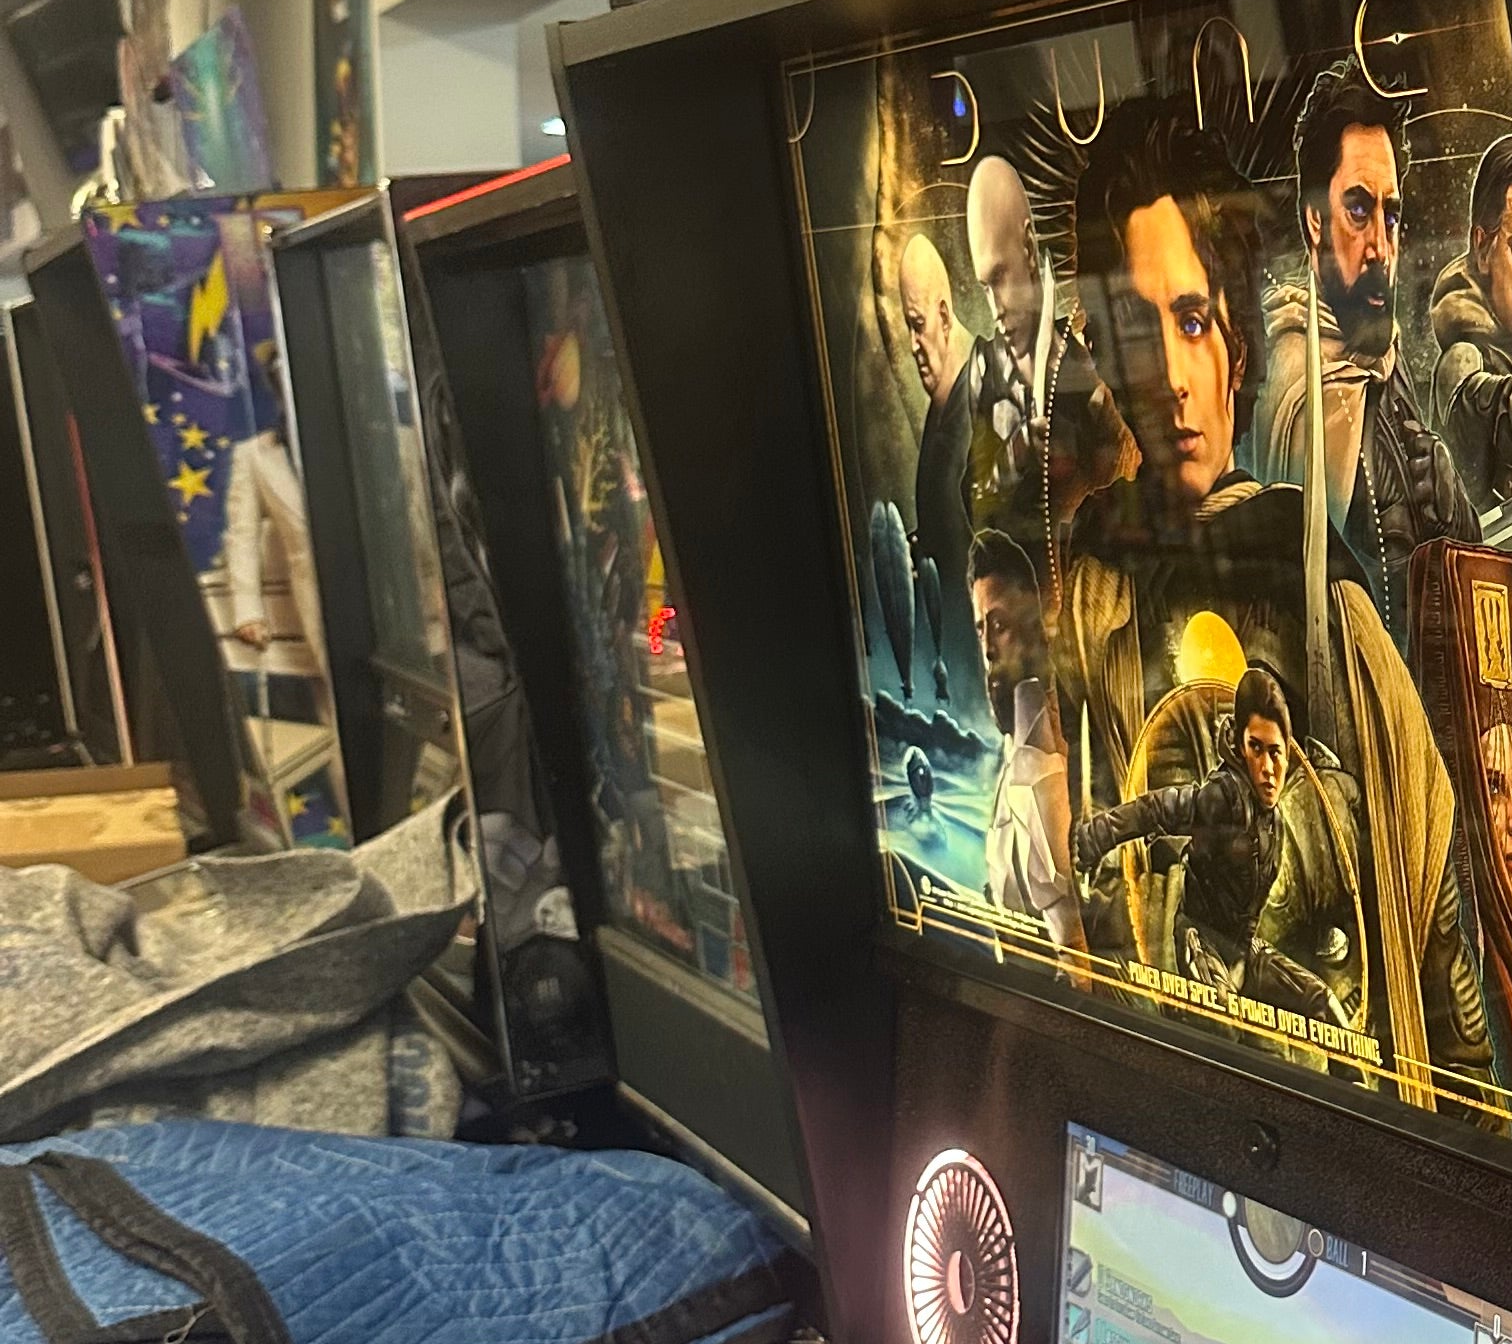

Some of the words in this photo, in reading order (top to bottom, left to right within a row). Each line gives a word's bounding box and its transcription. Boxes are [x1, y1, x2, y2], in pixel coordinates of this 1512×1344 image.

[1127, 960, 1160, 991] POWER
[1161, 971, 1189, 1000] OVER
[1227, 991, 1241, 1017] IS
[1241, 996, 1277, 1029] POWER
[1277, 1008, 1308, 1040] OVER
[1325, 1235, 1350, 1268] BALL
